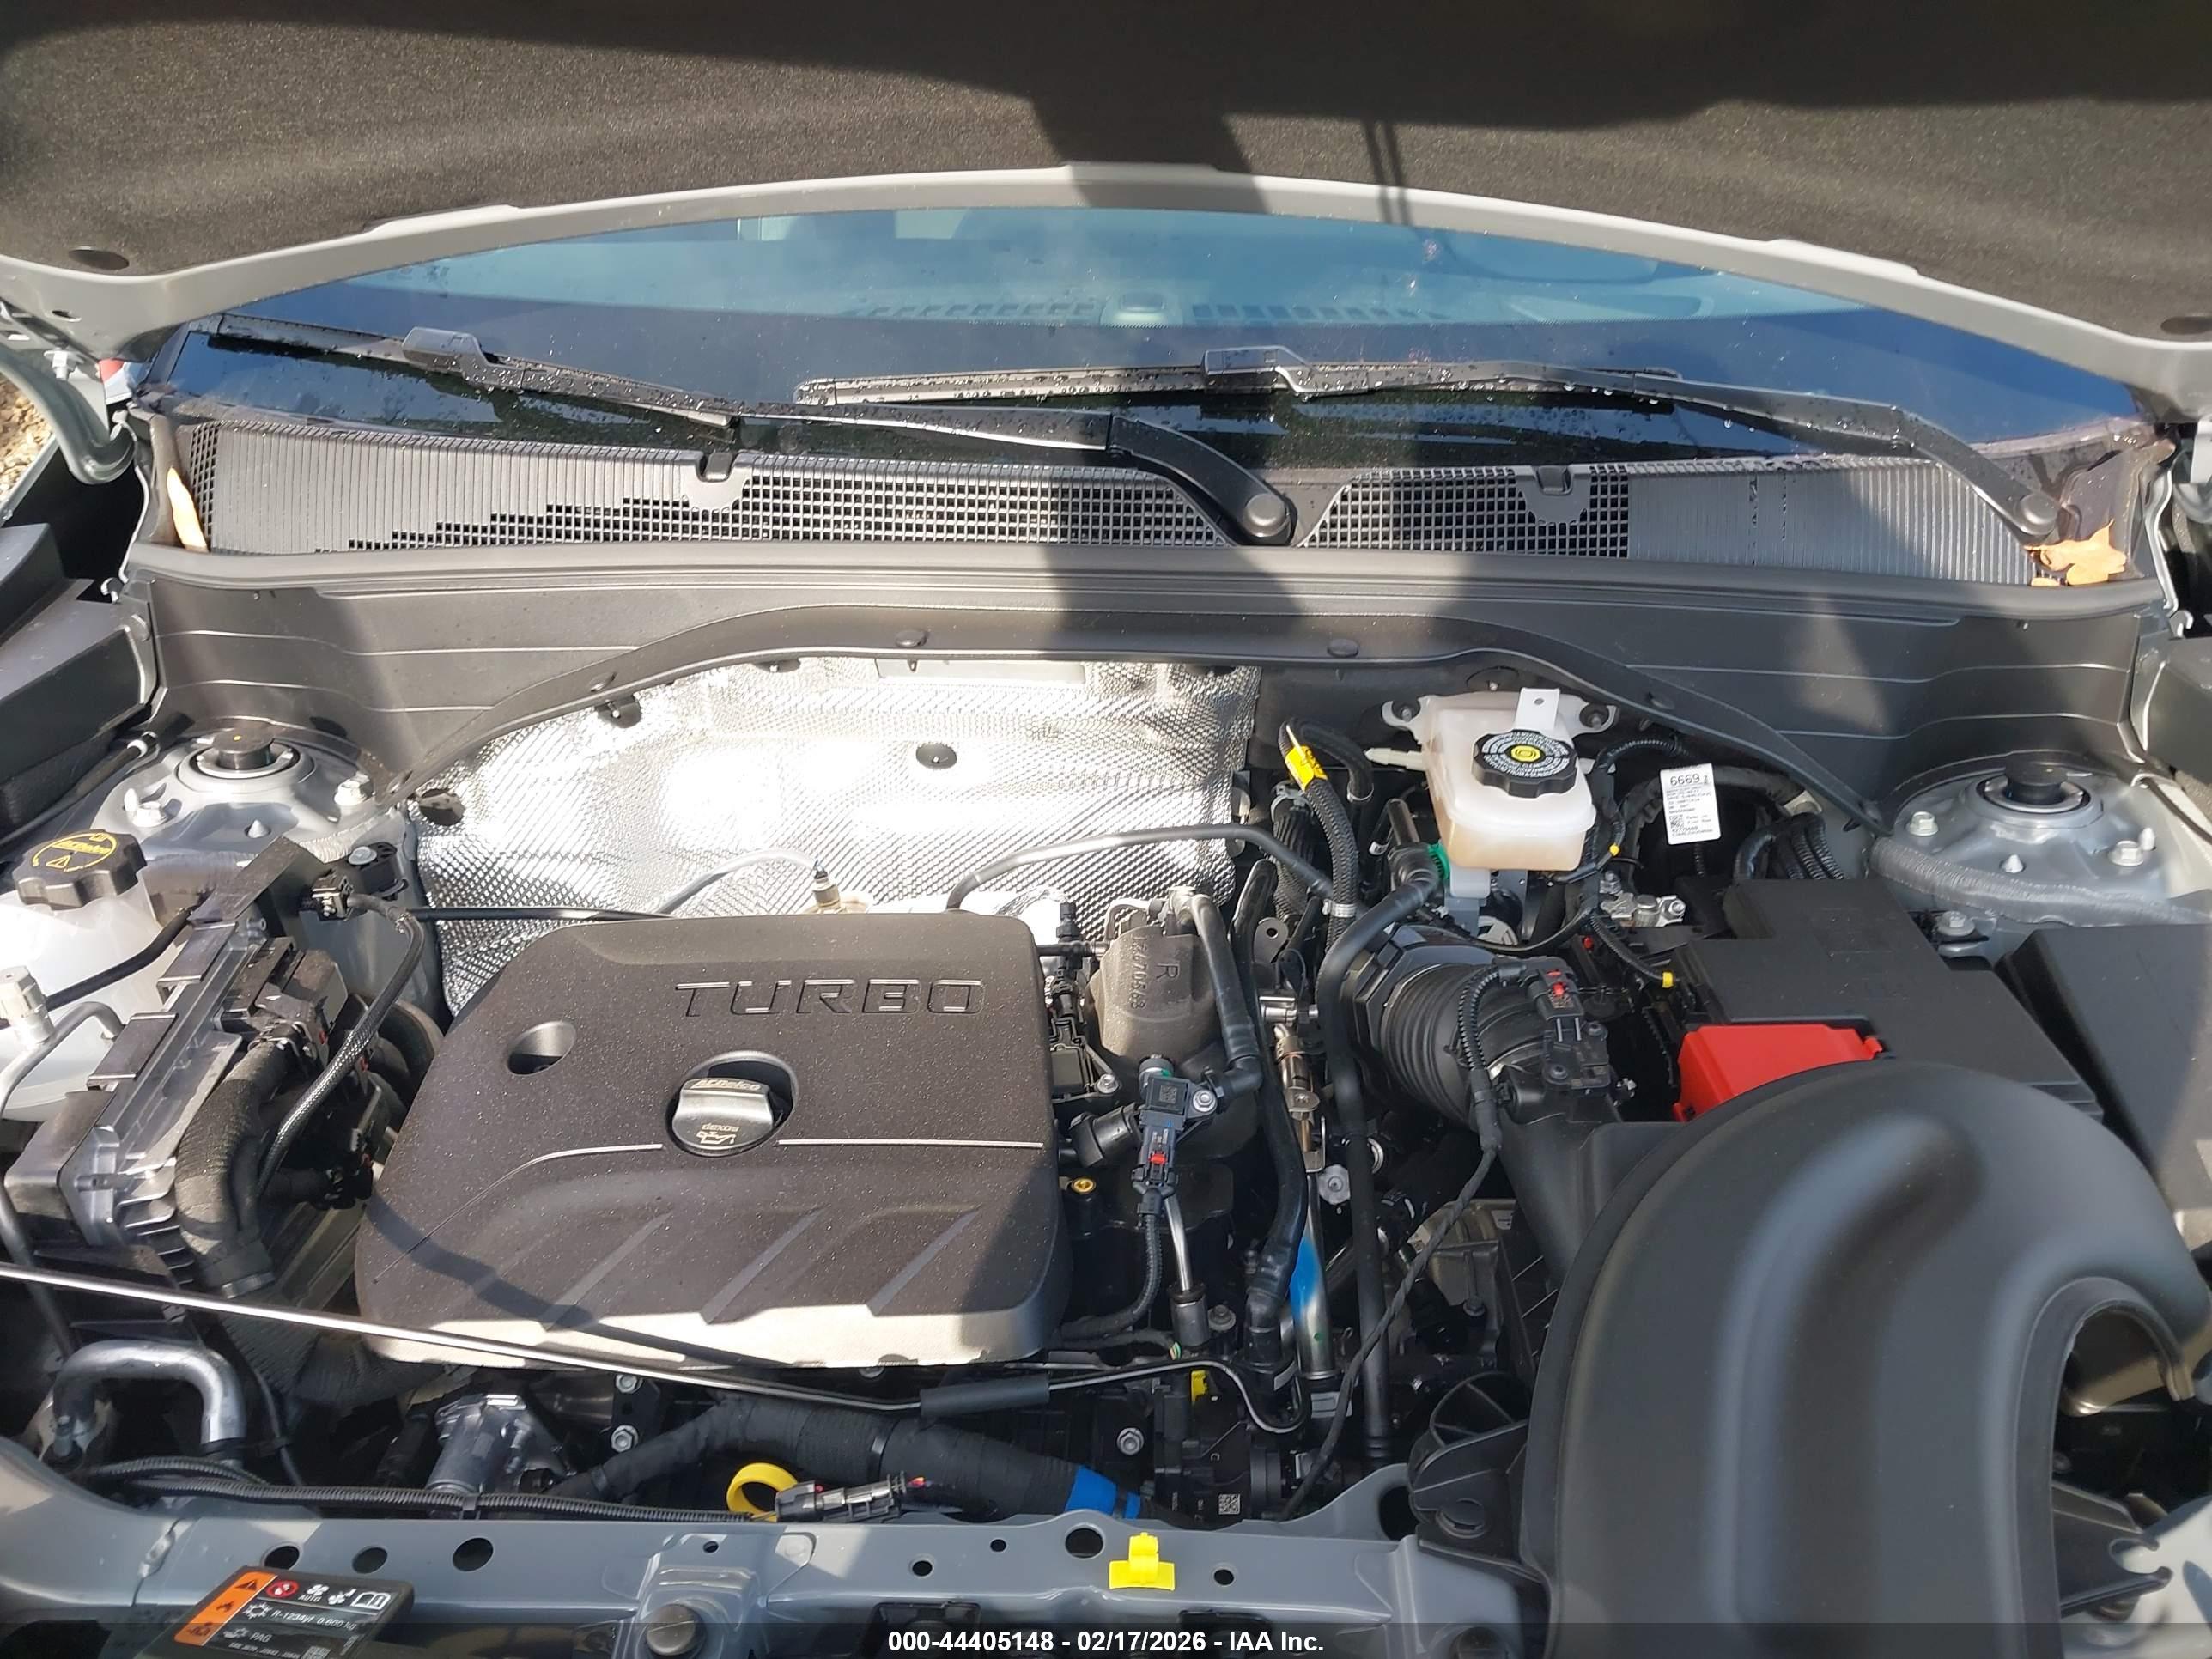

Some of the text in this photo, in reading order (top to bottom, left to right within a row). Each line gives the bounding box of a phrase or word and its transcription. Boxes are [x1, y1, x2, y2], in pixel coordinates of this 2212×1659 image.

[1670, 773, 1700, 786] 6669
[1156, 962, 1180, 980] R
[676, 978, 984, 1017] TURBO
[690, 1079, 762, 1091] ACDelco
[298, 1594, 322, 1602] AUTO
[270, 1609, 315, 1623] R-1234yf
